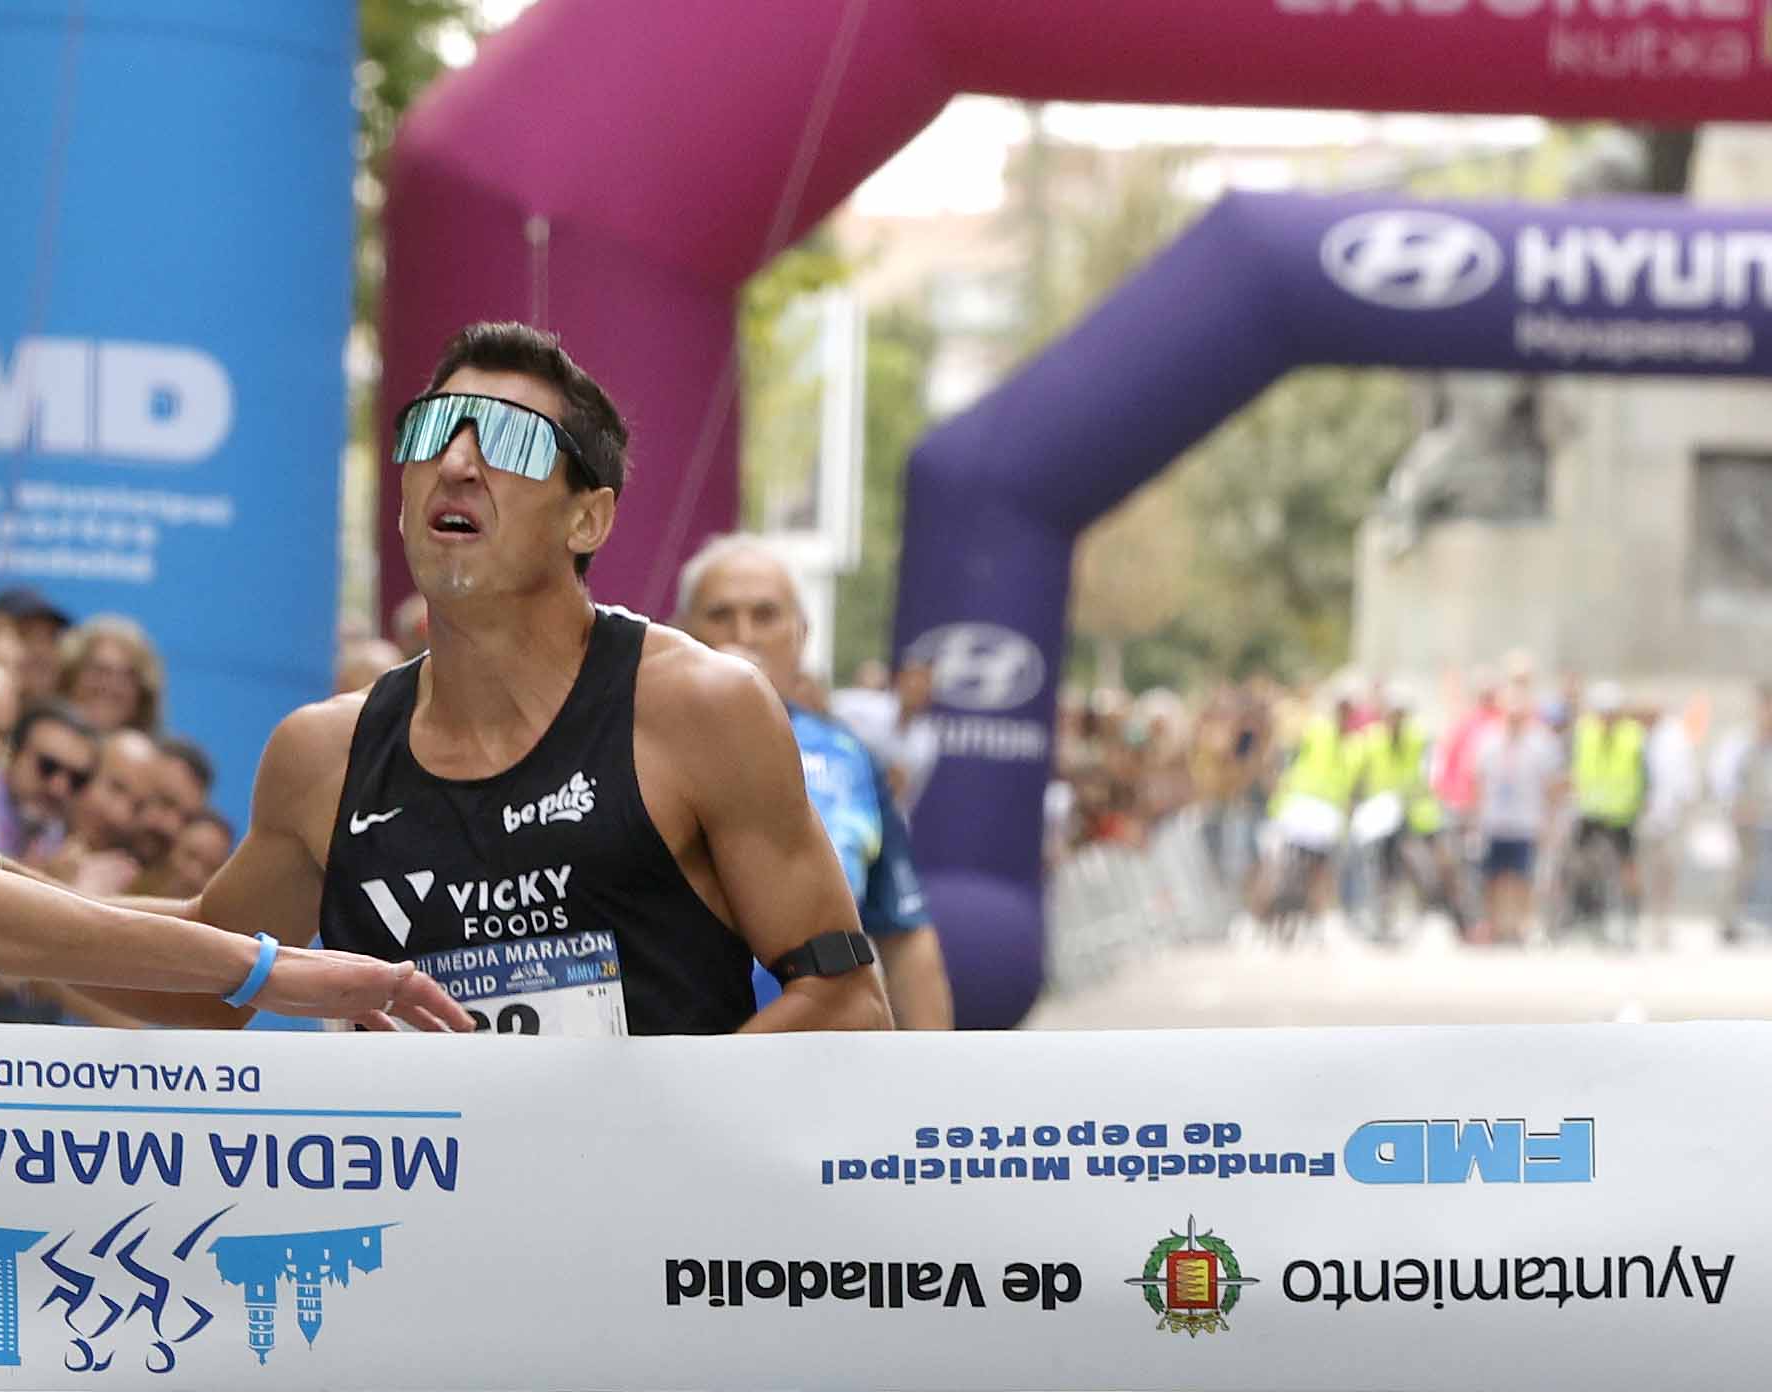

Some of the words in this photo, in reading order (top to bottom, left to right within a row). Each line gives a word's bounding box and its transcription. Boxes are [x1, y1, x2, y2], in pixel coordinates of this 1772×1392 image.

[447, 864, 572, 914] VICKY
[463, 905, 569, 940] FOODS
[436, 950, 500, 974] MEDIA
[505, 933, 614, 965] MARATÓN
[215, 1065, 260, 1093] DE
[916, 1120, 1168, 1151] Deportes
[1183, 1122, 1242, 1148] de
[1344, 1117, 1596, 1184] FMD
[208, 1133, 458, 1192] MEDIA
[822, 1155, 1070, 1186] Municipal
[1087, 1151, 1336, 1182] Fundación
[665, 1258, 987, 1309] Valladolid
[1002, 1262, 1082, 1311] de
[1282, 1254, 1736, 1311] Ayuntamiento
